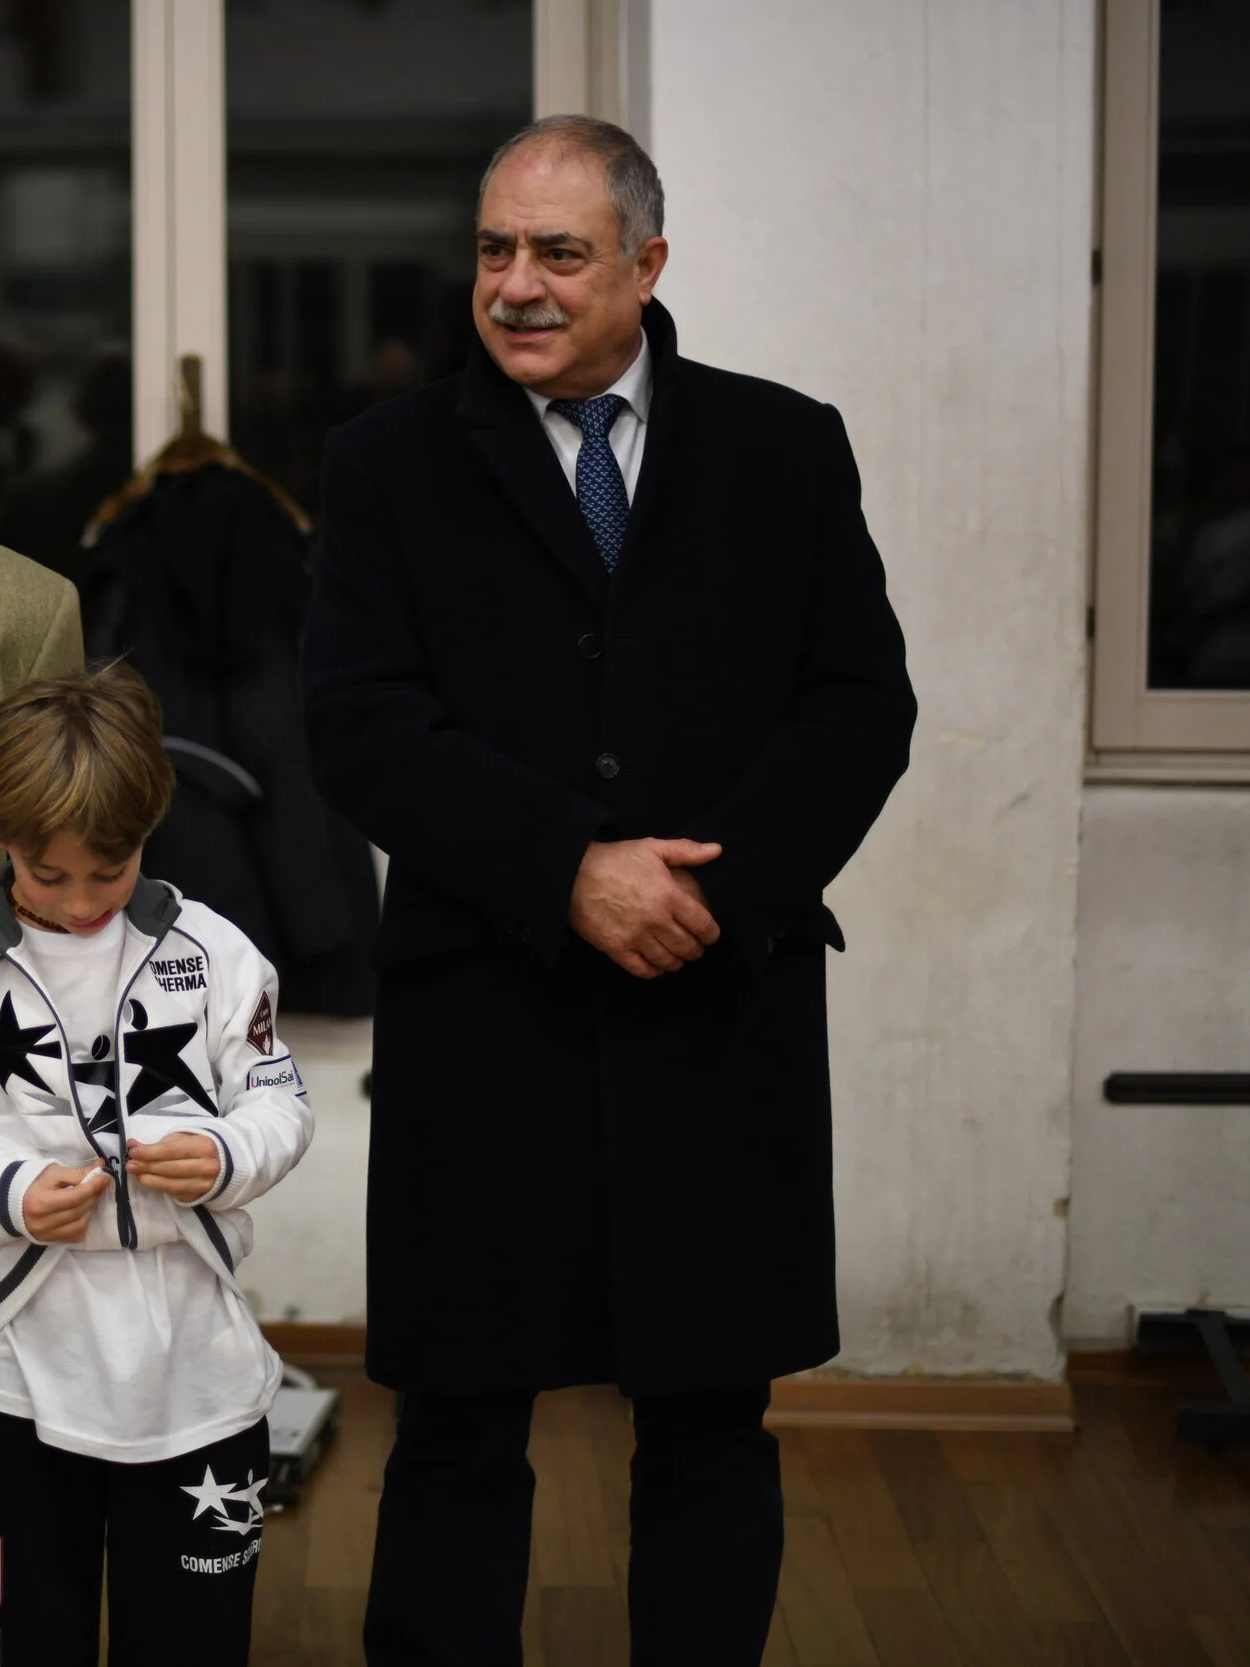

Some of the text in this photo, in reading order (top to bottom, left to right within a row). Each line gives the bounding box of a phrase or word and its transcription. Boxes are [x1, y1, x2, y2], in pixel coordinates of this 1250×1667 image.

[149, 956, 204, 976] OMENSE
[155, 973, 207, 992] HERMA
[251, 1071, 294, 1088] UnipolSai
[180, 1552, 242, 1574] COMENSE
